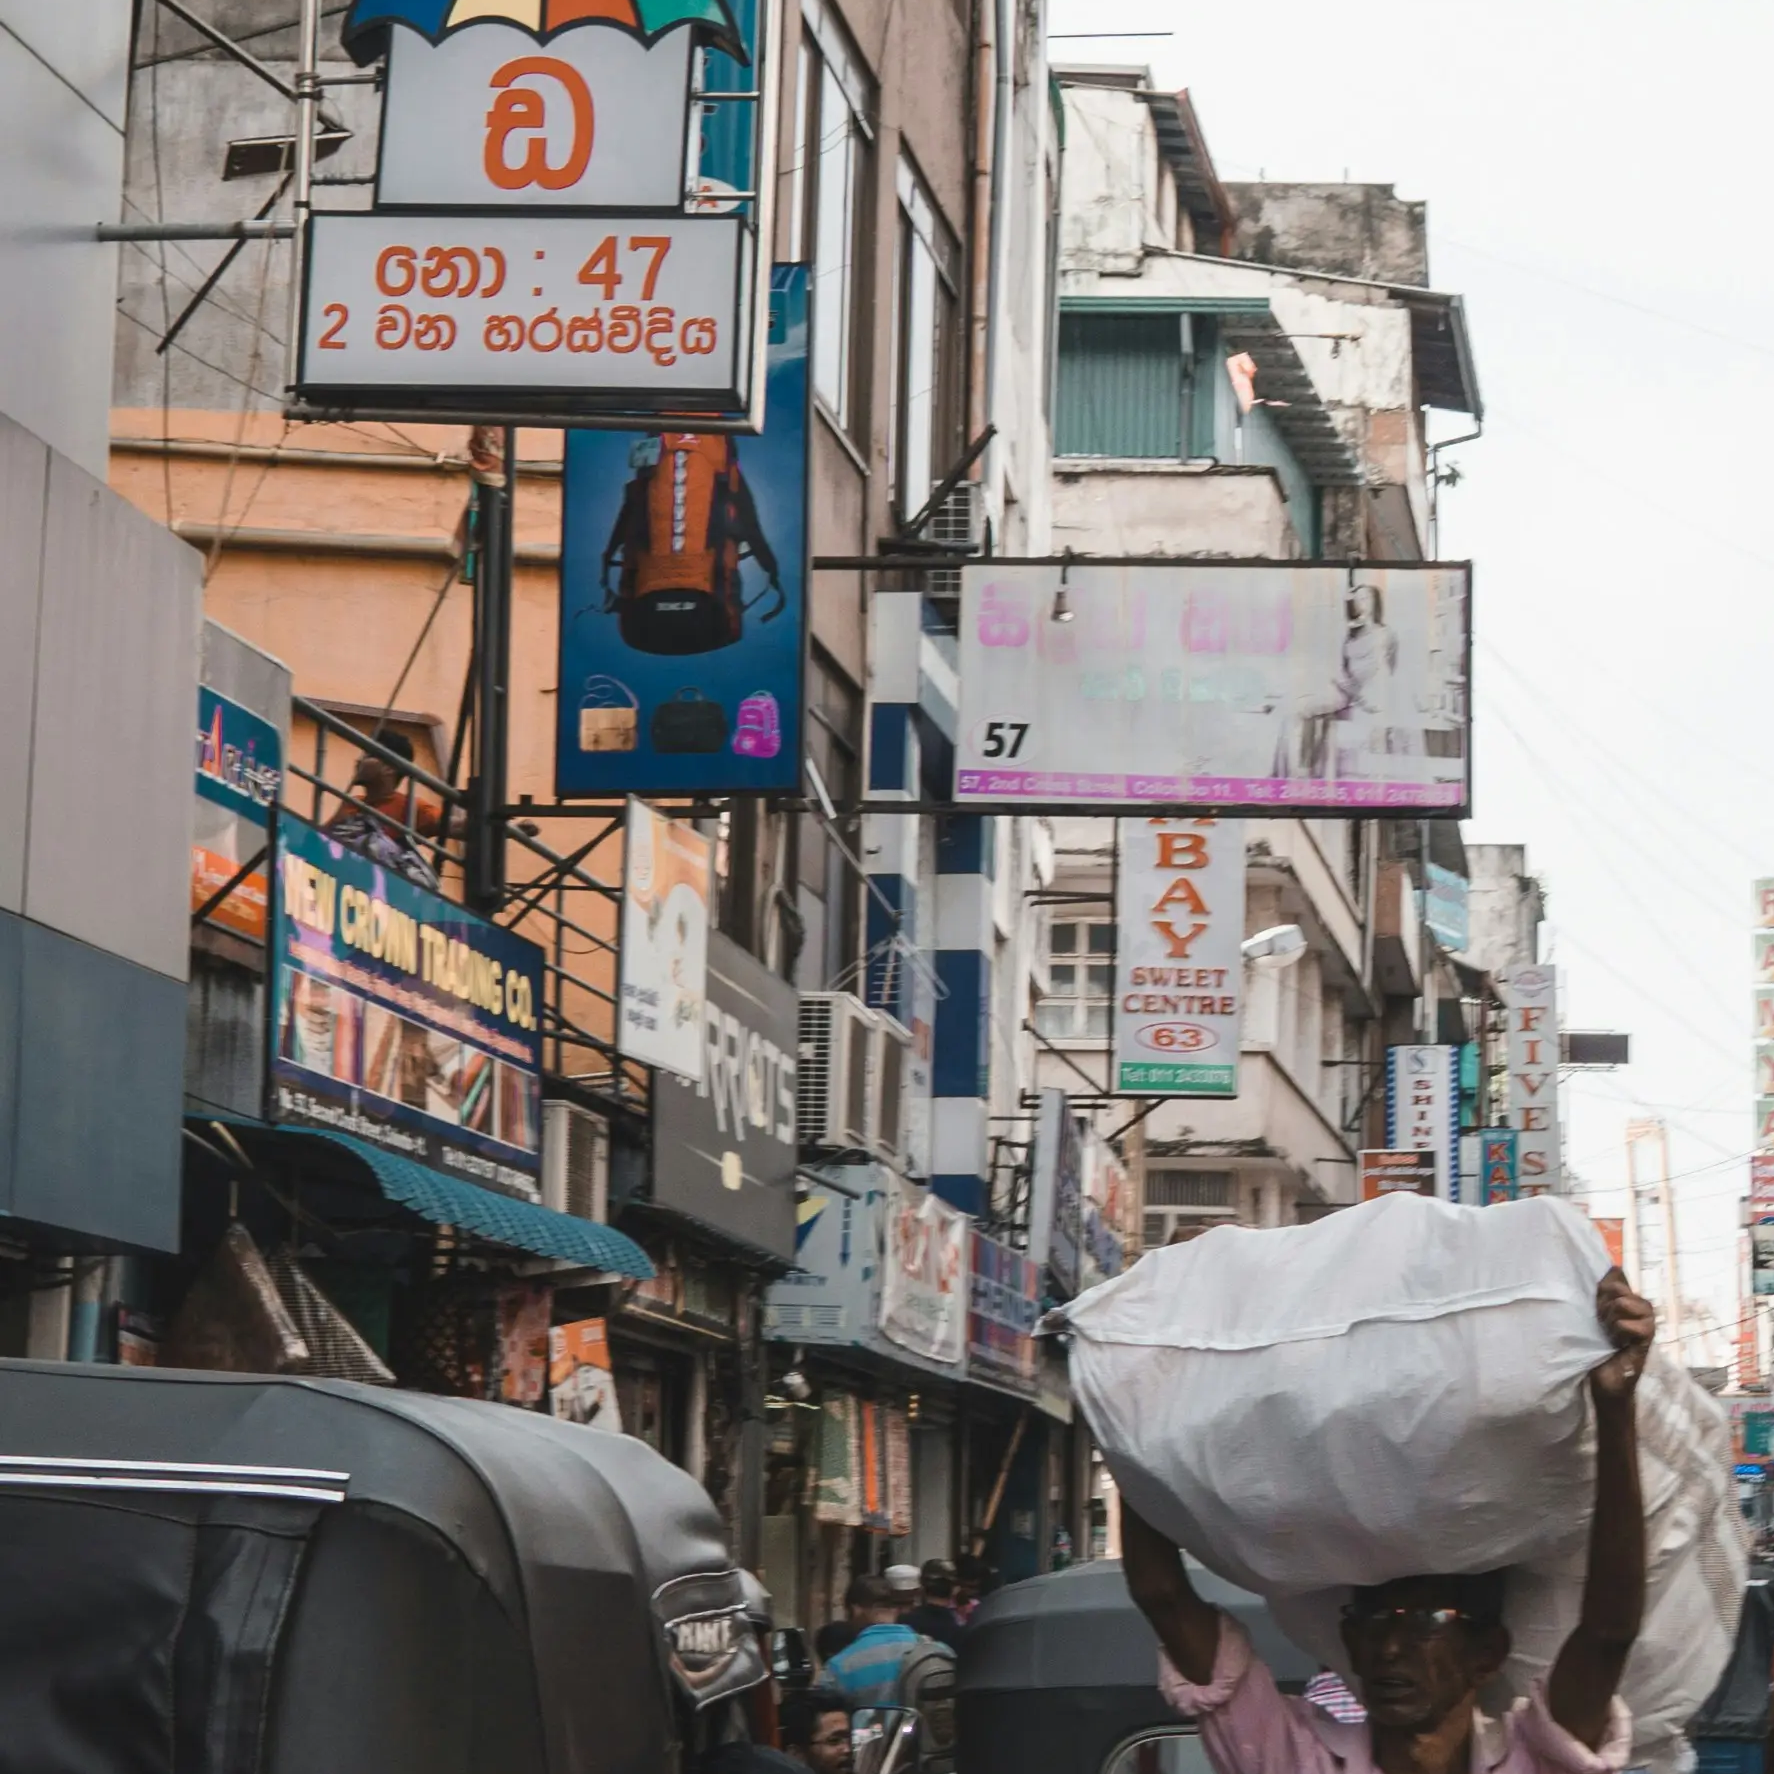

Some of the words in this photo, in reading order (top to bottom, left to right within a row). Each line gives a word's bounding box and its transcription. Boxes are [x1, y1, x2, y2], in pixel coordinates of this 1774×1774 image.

[577, 234, 672, 302] 47
[317, 302, 350, 351] 2
[982, 721, 1029, 759] 57
[283, 852, 337, 937] NEW
[339, 883, 418, 975] CROWN
[419, 921, 504, 1017] TRADING
[1130, 966, 1230, 989] SWEET
[1122, 993, 1237, 1016] CENTRE
[1152, 1027, 1204, 1048] 63
